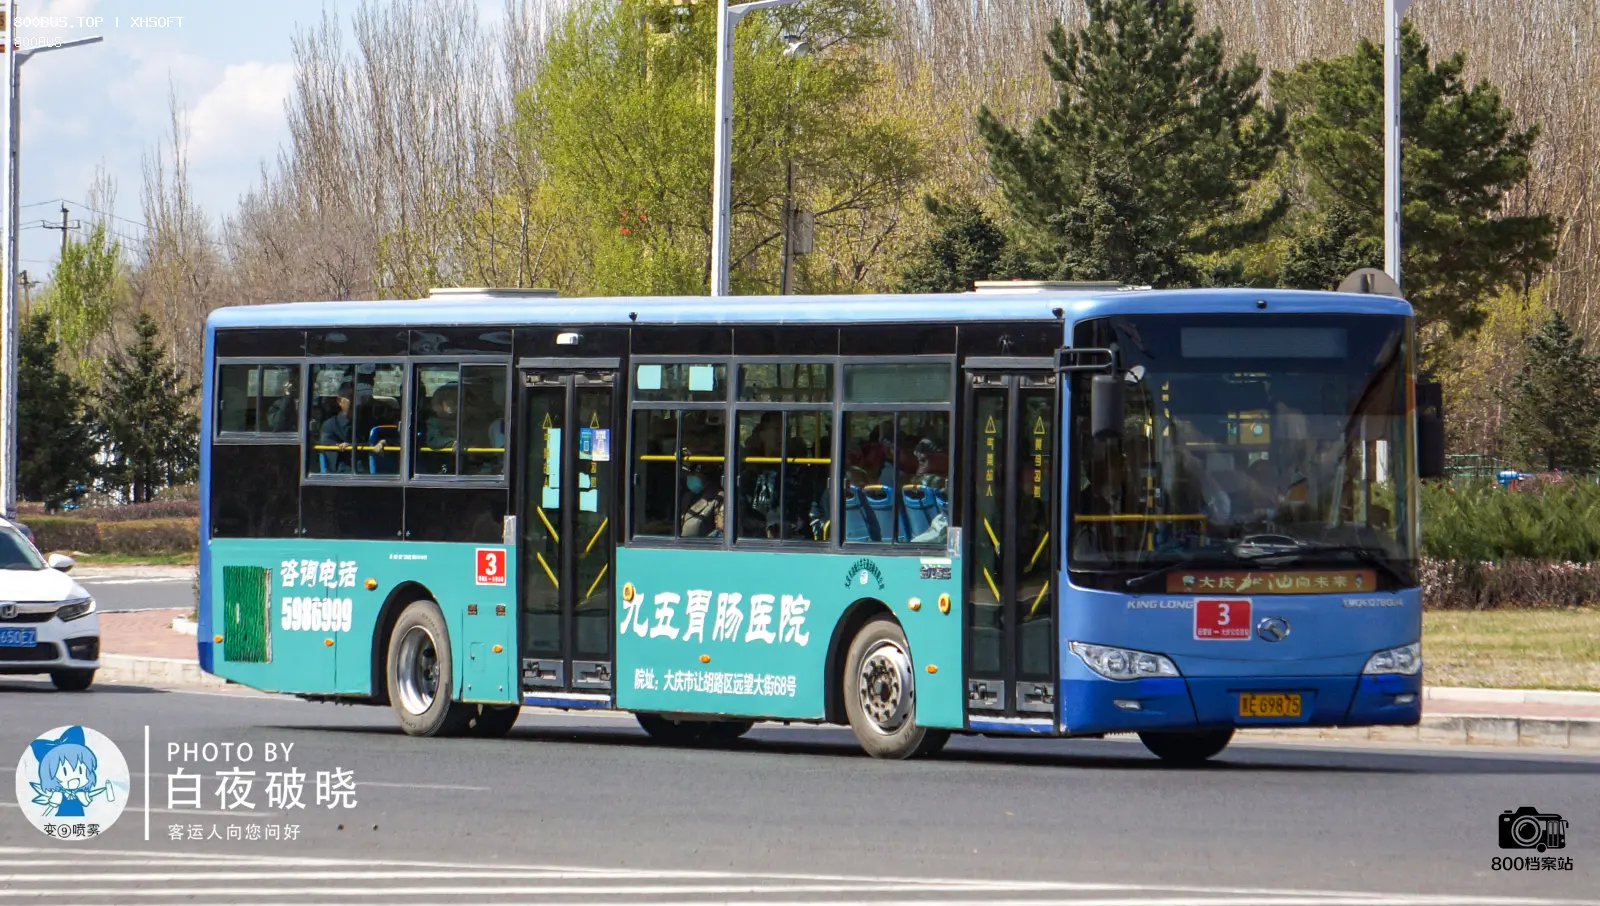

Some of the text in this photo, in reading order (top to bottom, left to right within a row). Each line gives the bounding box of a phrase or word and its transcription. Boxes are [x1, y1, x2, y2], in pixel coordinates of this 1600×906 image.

[280, 558, 358, 588] 咨询电话
[485, 552, 497, 576] 3
[281, 596, 353, 632] 5986999
[620, 589, 811, 646] 九五胃肠医院
[1127, 600, 1194, 609] KING LONG
[1217, 603, 1231, 626] 3
